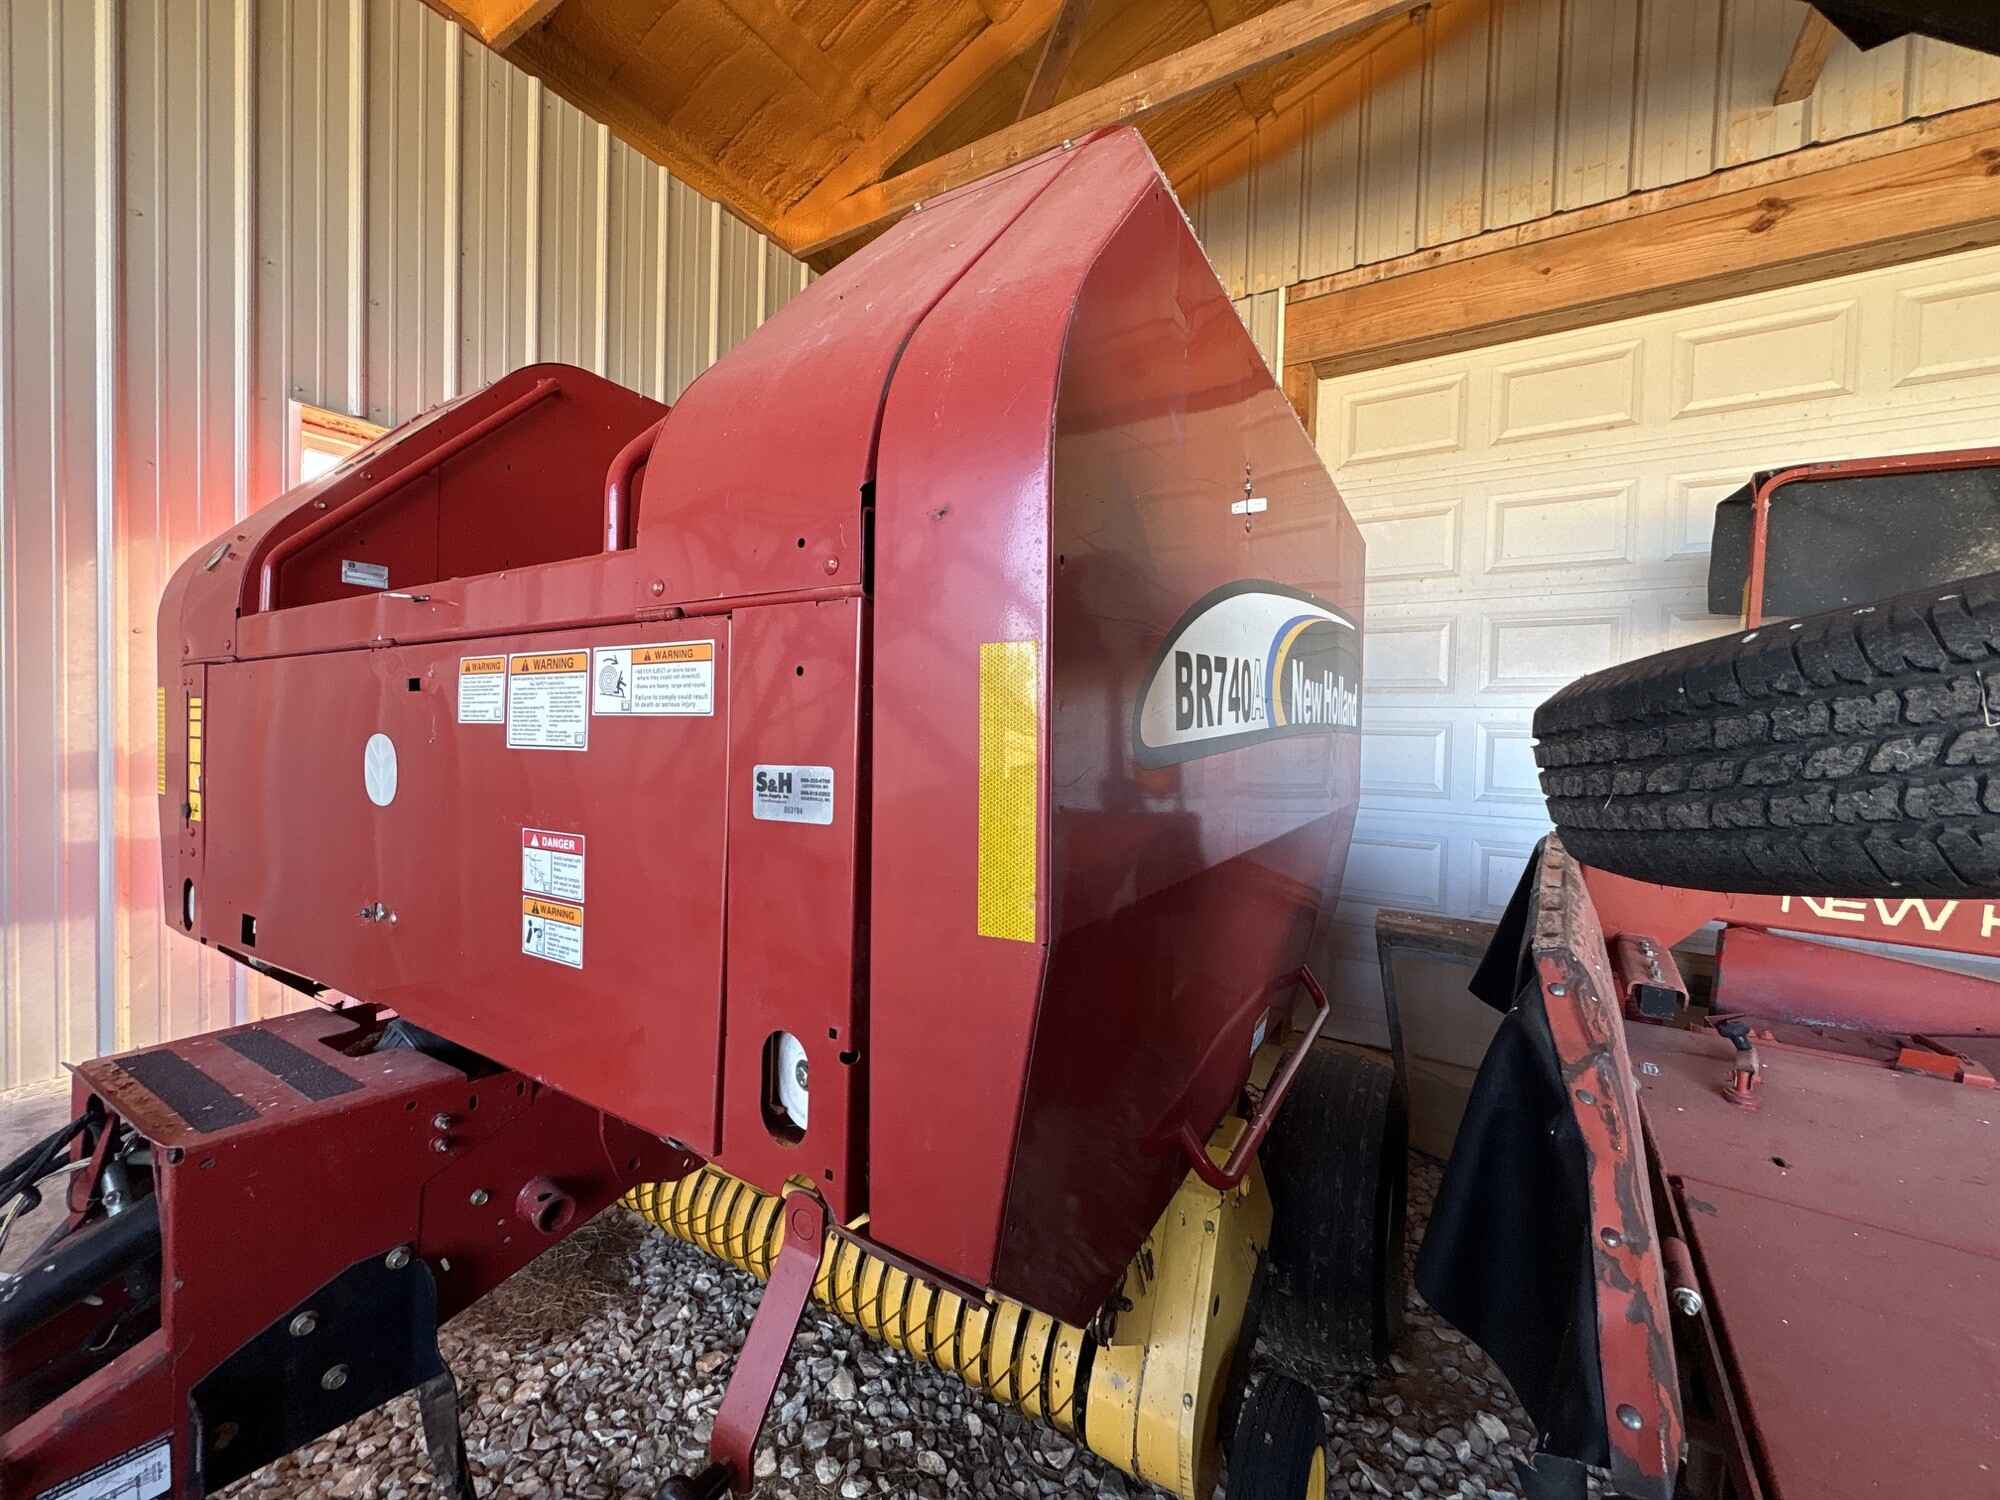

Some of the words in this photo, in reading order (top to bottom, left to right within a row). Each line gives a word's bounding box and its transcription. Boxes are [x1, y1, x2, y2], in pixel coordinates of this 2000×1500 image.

[654, 649, 693, 660] WARNING
[472, 662, 501, 671] WARNING
[533, 657, 574, 671] WARNING
[1175, 650, 1265, 731] BR740A
[1291, 659, 1323, 725] New
[1323, 670, 1358, 728] Holland
[756, 772, 793, 794] S&H
[541, 836, 575, 851] DANGER
[540, 904, 575, 921] WARNING
